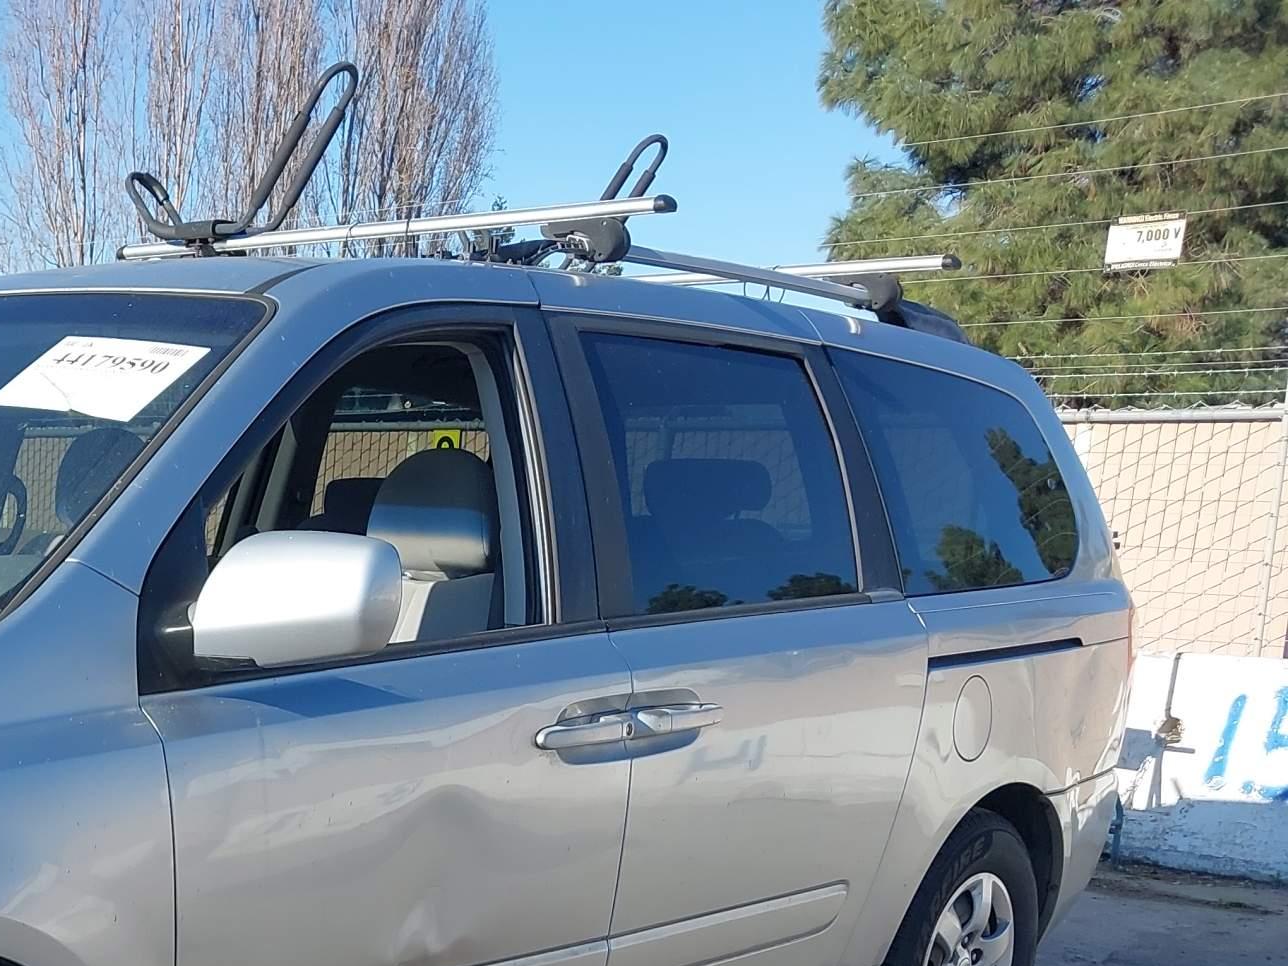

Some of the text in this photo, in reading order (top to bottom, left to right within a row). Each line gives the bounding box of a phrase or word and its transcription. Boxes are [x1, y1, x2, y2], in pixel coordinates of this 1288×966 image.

[1136, 227, 1181, 243] 7,000 V
[53, 352, 170, 375] 44179590
